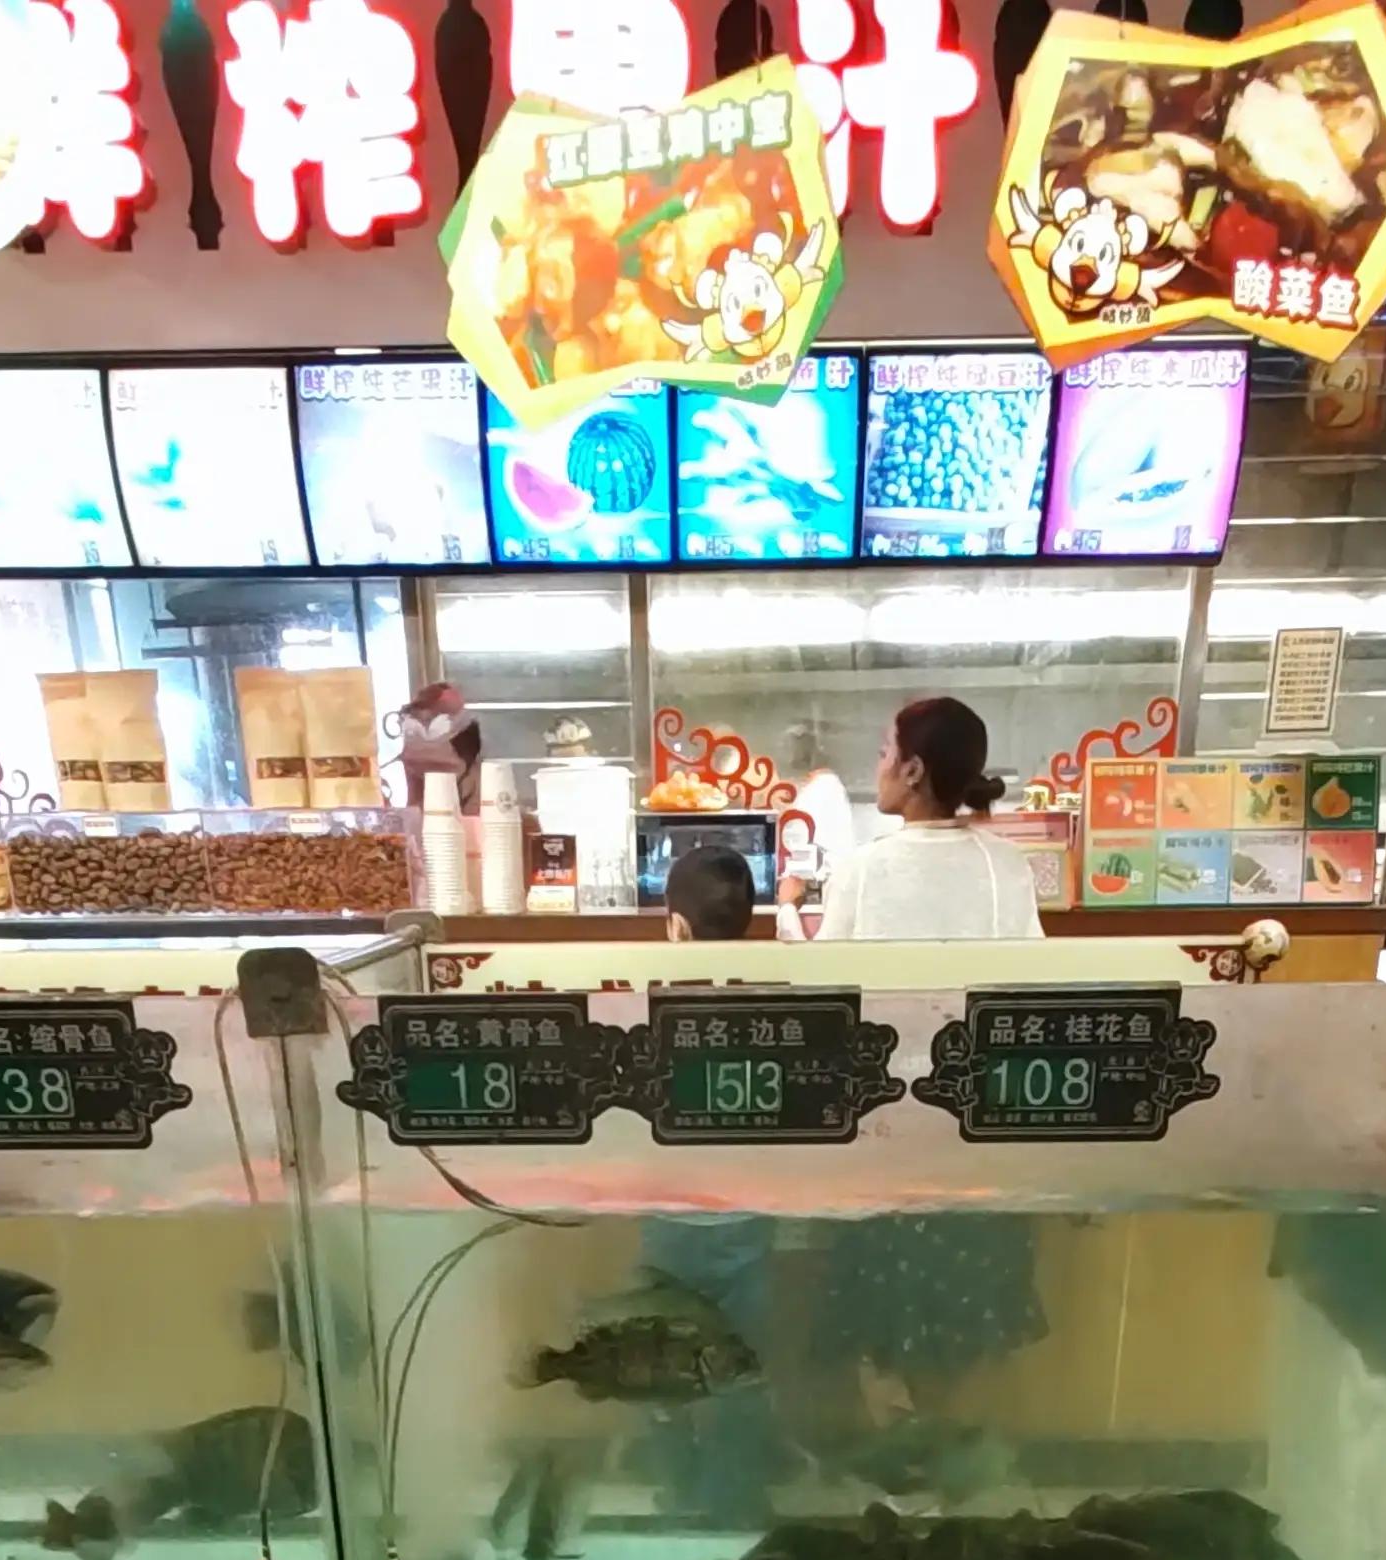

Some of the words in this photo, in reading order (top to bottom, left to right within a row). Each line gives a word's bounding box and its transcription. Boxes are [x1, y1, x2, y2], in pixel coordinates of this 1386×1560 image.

[1234, 260, 1355, 325] 酸菜鱼
[405, 1018, 563, 1048] 品名：黄骨鱼
[674, 1018, 806, 1048] 品名：边鱼
[989, 1013, 1154, 1045] 品名：桂花鱼
[3, 1068, 69, 1114] 38
[451, 1062, 511, 1109] 18
[992, 1057, 1090, 1106] 108
